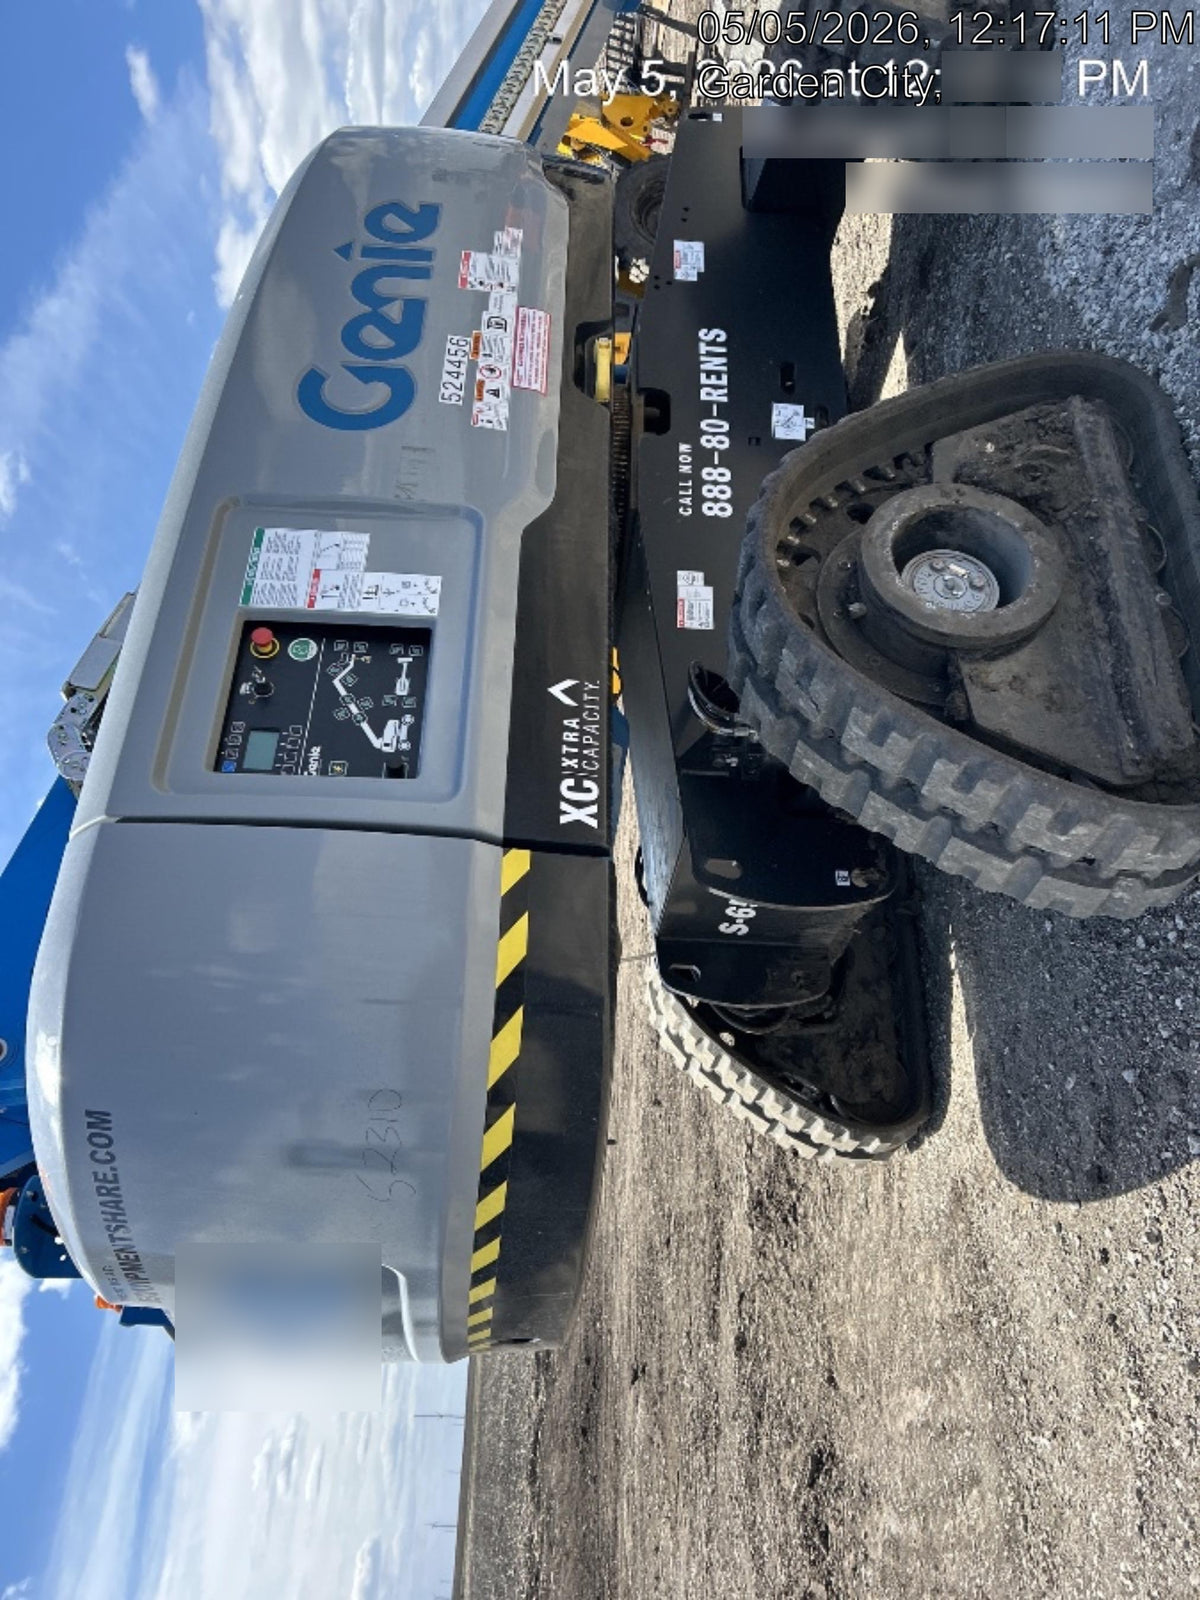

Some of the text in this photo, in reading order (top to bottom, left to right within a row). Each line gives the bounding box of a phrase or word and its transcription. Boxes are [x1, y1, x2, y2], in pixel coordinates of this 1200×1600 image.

[297, 201, 442, 431] Genie
[440, 337, 469, 402] 524456
[699, 328, 734, 518] 888-80-RENTS
[678, 442, 693, 516] CALL NOW
[559, 718, 599, 829] XC XTRA
